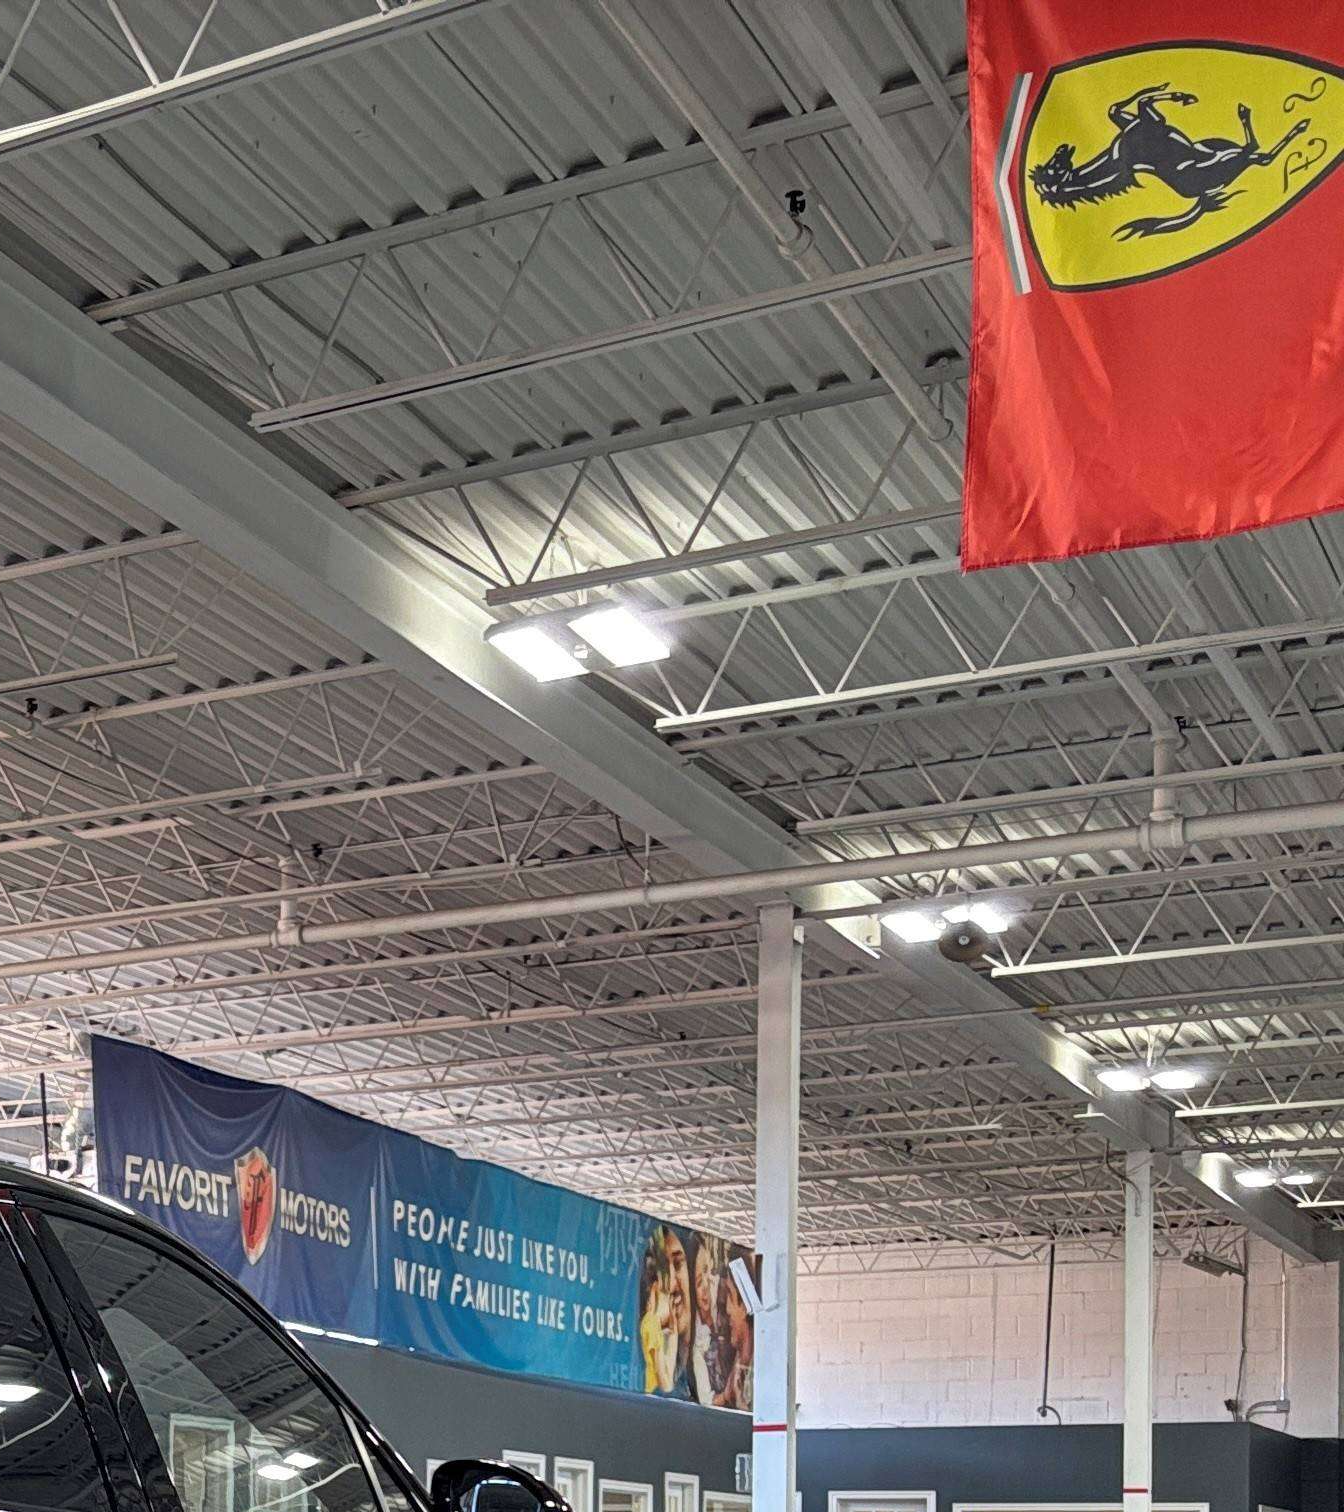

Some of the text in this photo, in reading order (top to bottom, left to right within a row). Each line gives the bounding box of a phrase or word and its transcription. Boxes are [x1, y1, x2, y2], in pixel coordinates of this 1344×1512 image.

[123, 1154, 352, 1249] FAVORIT MOTORS
[393, 1257, 631, 1344] WITH FAMILIES LIKE YOURS.
[473, 1225, 515, 1265] JUST
[521, 1237, 556, 1276] LIKE
[558, 1248, 595, 1290] YOU,
